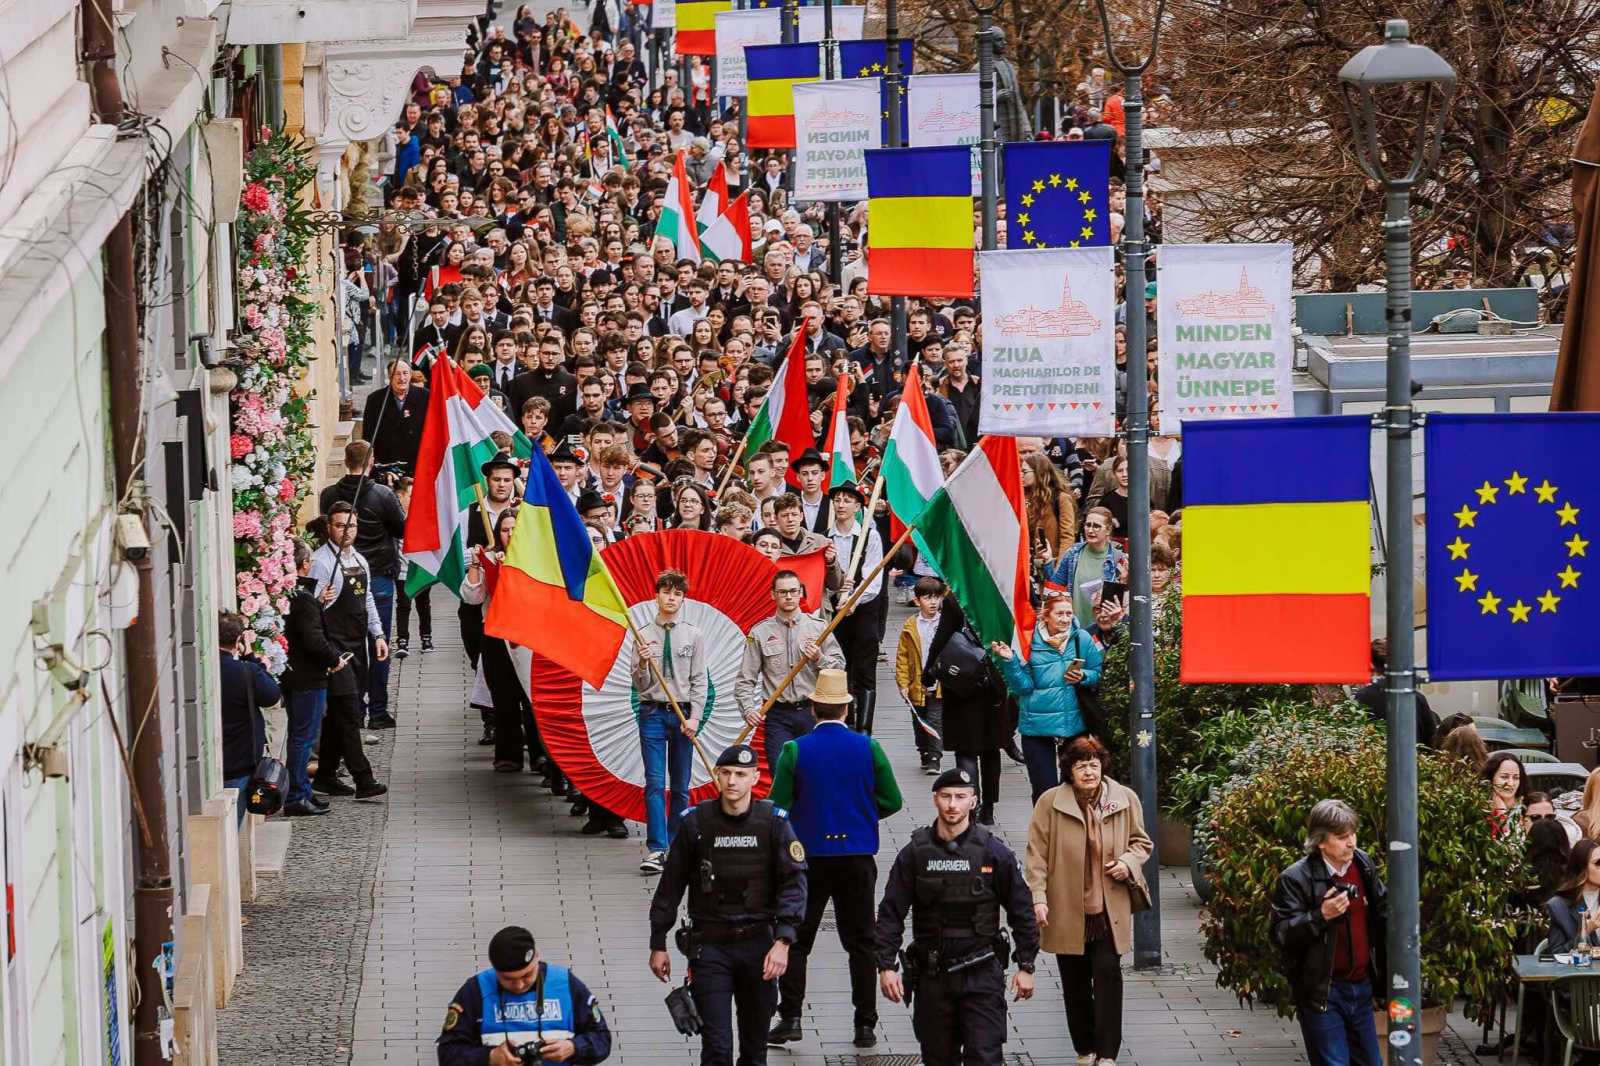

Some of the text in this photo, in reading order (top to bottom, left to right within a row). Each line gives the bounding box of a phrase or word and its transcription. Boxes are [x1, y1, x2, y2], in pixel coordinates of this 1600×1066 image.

[1175, 323, 1272, 342] MINDEN
[992, 347, 1043, 363] ZIUA
[1175, 351, 1276, 370] MAGYAR
[992, 366, 1102, 378] MAGHIARILOR DE
[992, 382, 1099, 396] PRETUTINDENI
[1175, 375, 1276, 398] ÜNNEPE
